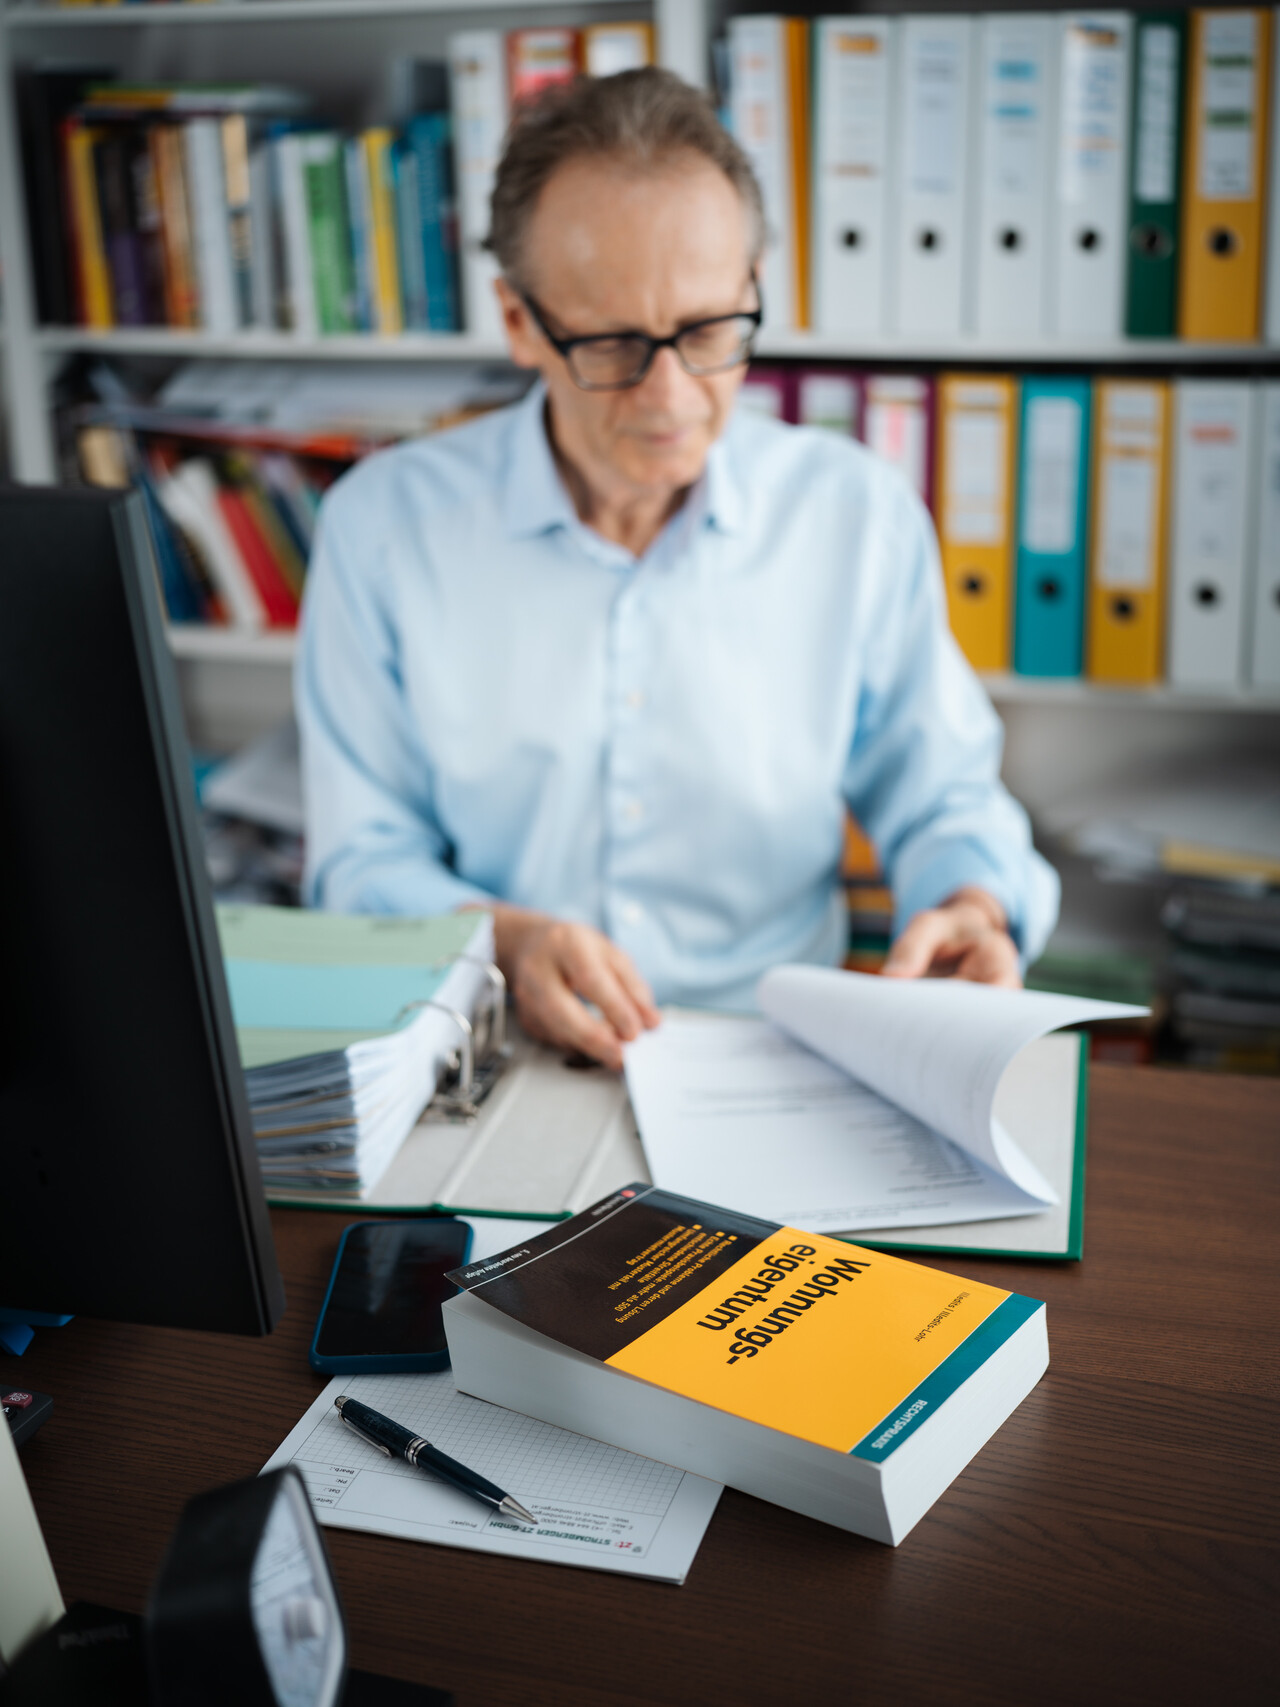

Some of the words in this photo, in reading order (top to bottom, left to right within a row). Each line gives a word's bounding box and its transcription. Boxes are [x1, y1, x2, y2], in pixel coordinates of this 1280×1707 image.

[651, 1228, 696, 1261] Umfangreicher
[667, 1232, 707, 1262] entschiedene
[698, 1235, 720, 1249] Echte
[698, 1240, 732, 1263] Rechtliche
[619, 1260, 654, 1283] Musterteil
[638, 1260, 671, 1283] Streitfälle
[653, 1248, 703, 1283] Praxisbeispiele:
[670, 1262, 703, 1285] Probleme
[608, 1281, 622, 1291] mit
[638, 1282, 656, 1296] mehr
[658, 1284, 672, 1295] und
[696, 1244, 816, 1331] eigentum
[614, 1301, 631, 1312] 500
[626, 1294, 639, 1303] als
[640, 1293, 660, 1308] deren
[615, 1305, 644, 1323] Lösung
[726, 1257, 872, 1365] Wohnungs-
[871, 1399, 928, 1449] RECHTSPRAXIS
[536, 1528, 611, 1545] STROMBERGER
